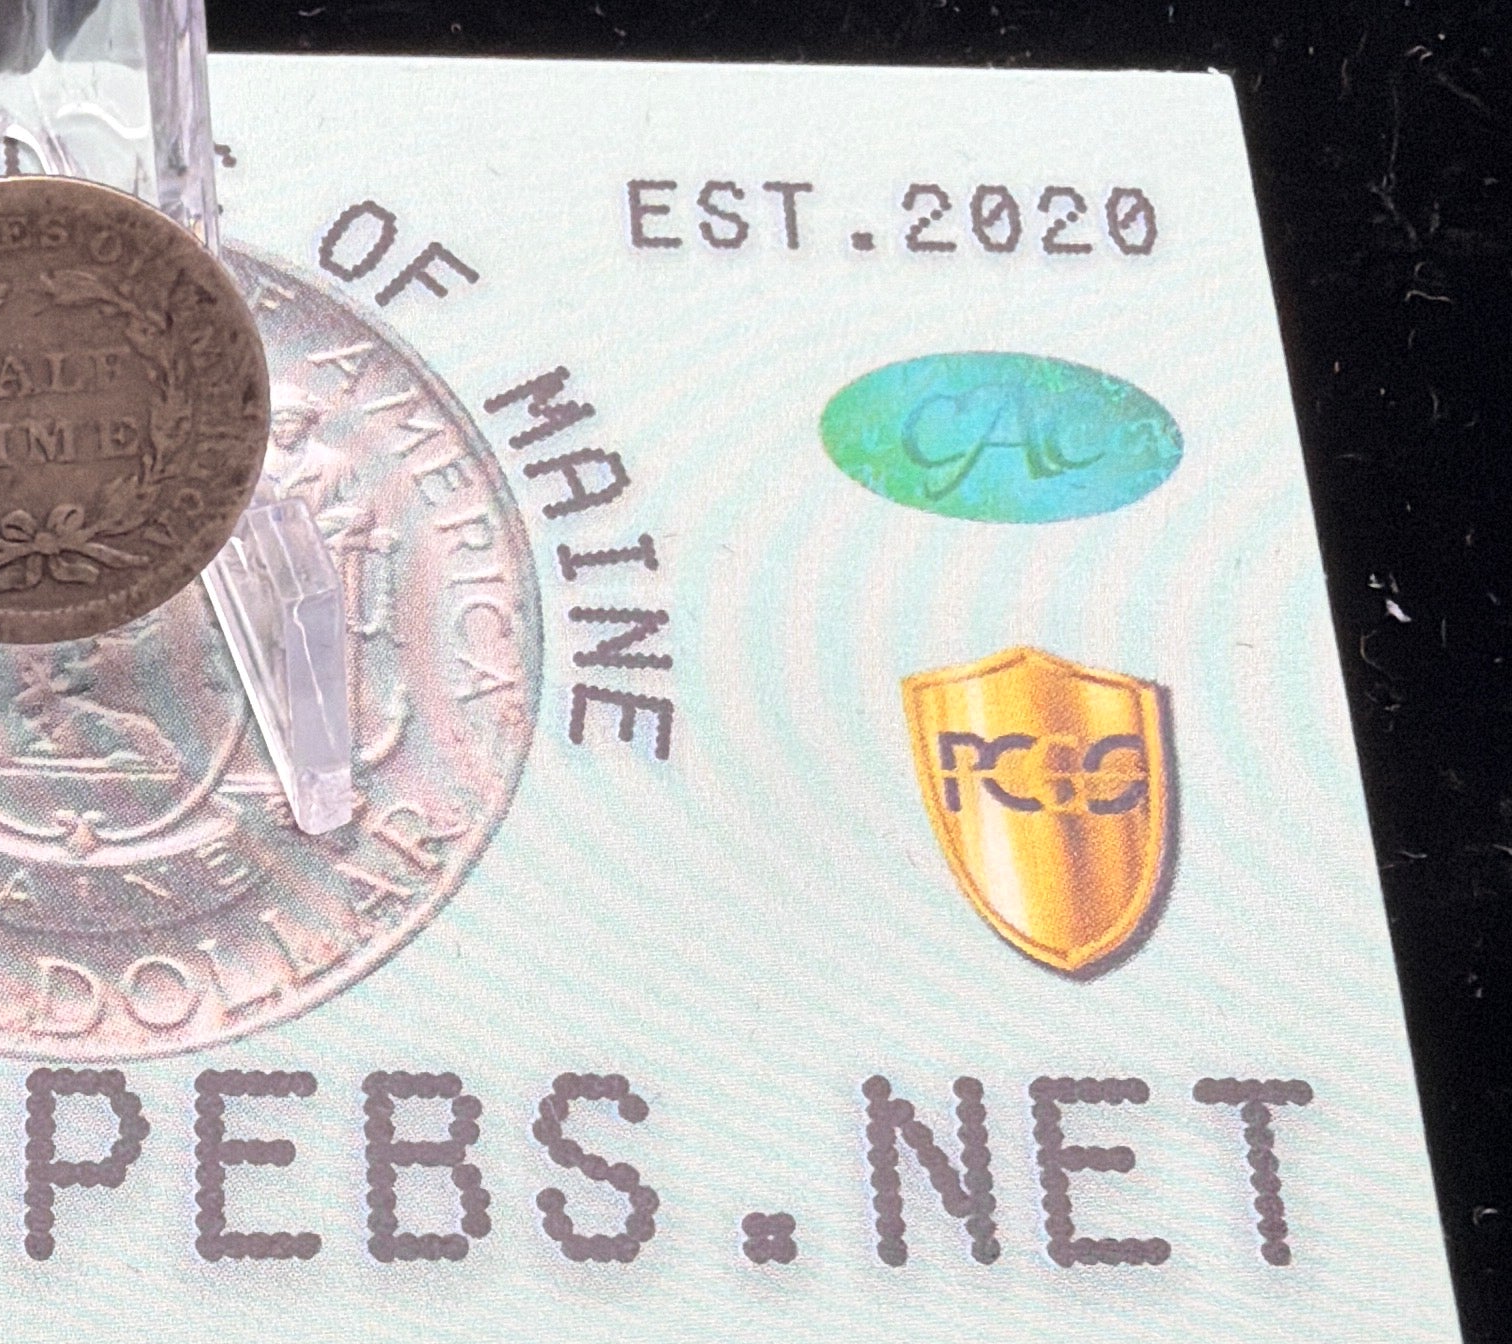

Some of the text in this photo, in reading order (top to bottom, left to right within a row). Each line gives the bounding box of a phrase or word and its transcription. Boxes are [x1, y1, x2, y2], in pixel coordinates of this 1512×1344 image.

[628, 180, 1158, 255] EST.2020
[306, 340, 514, 706] AMERICA
[321, 202, 478, 306] OF
[487, 368, 673, 759] MAINE
[33, 802, 476, 1041] DOLLAR
